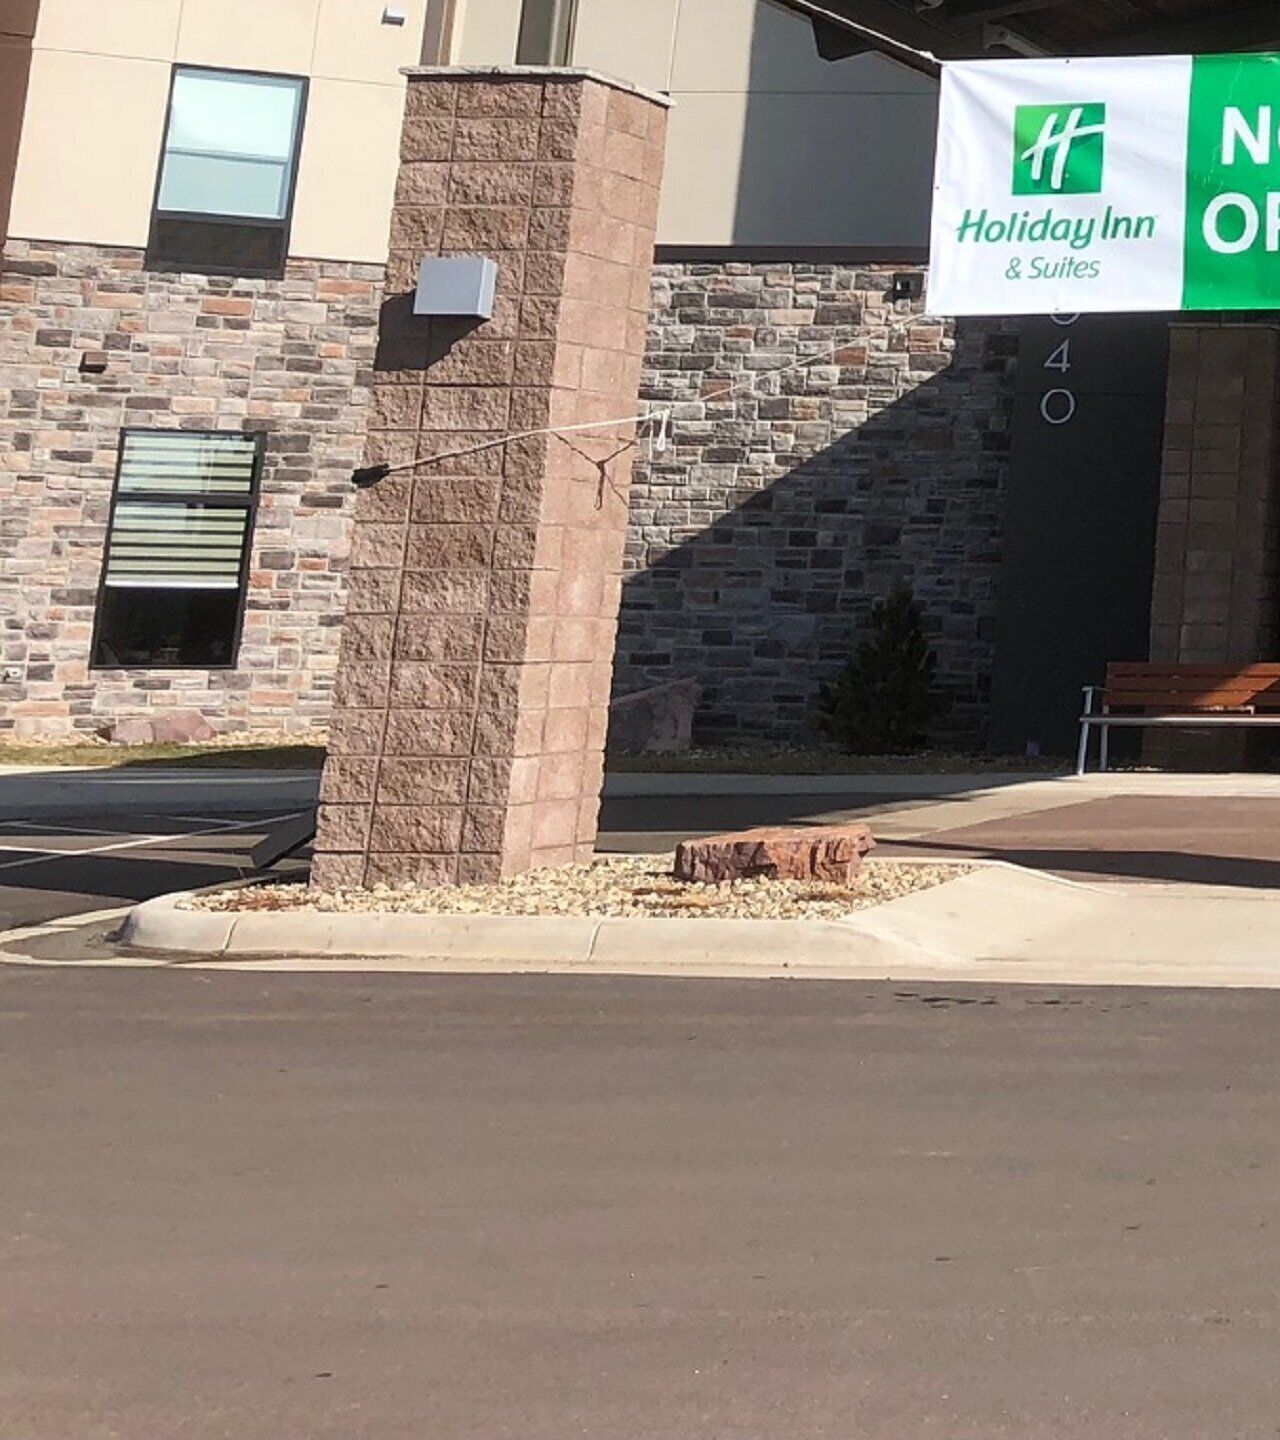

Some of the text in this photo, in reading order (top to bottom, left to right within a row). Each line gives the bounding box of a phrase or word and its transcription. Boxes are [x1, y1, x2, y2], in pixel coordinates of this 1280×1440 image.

[955, 205, 1156, 250] Holiday Inn
[1004, 256, 1101, 280] & Suites
